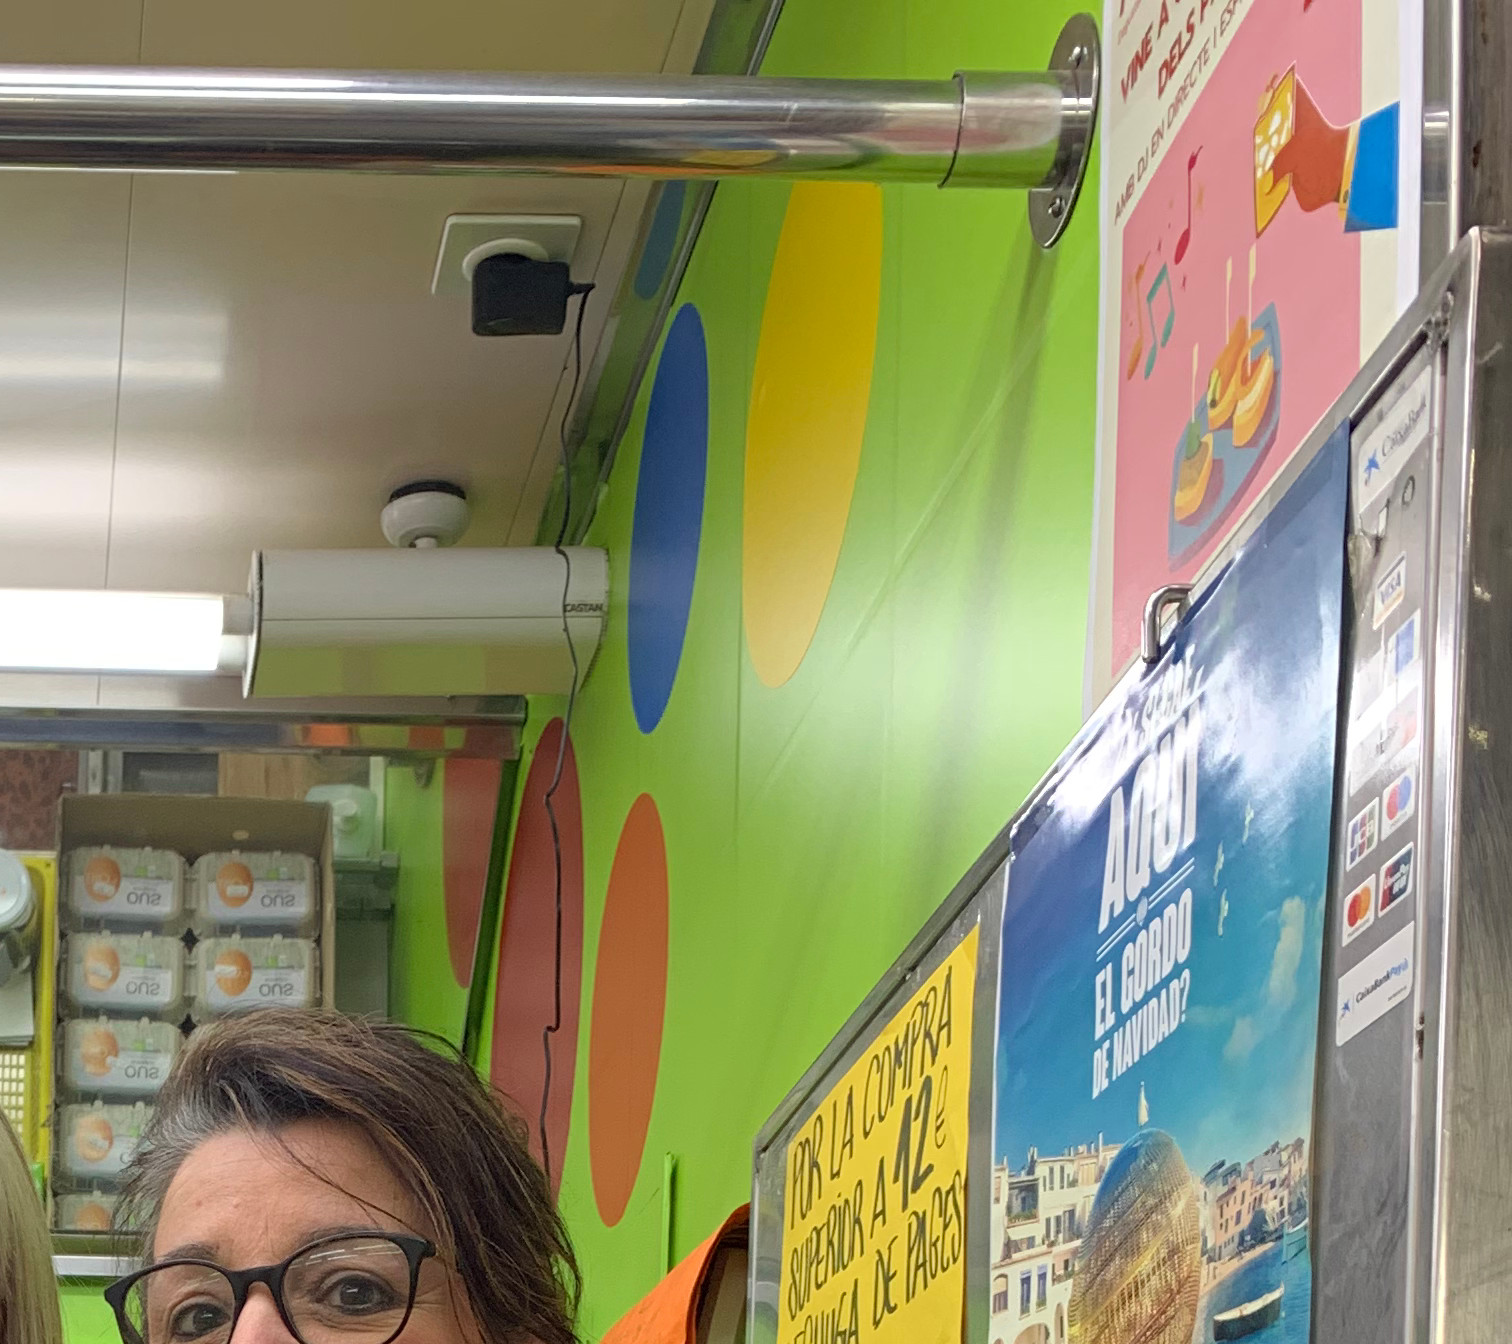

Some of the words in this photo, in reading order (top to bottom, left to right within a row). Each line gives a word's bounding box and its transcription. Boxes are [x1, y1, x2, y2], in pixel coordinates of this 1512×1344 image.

[1120, 21, 1154, 104] VINE
[1158, 7, 1196, 100] DELS
[1114, 176, 1134, 225] AMB
[1137, 147, 1150, 184] DJ
[1150, 120, 1165, 159] EN
[1167, 37, 1210, 130] DIRECTE
[1094, 968, 1119, 1040] EL
[1120, 888, 1192, 1027] GORDO
[791, 1138, 823, 1231] POR
[829, 1102, 856, 1181] LA
[860, 964, 954, 1126] COMPRA
[1091, 1041, 1111, 1100] DE
[1112, 978, 1191, 1085] NAVIDAD?
[869, 1166, 888, 1241] A
[872, 1232, 900, 1331] DE
[903, 1167, 964, 1306] PAGES
